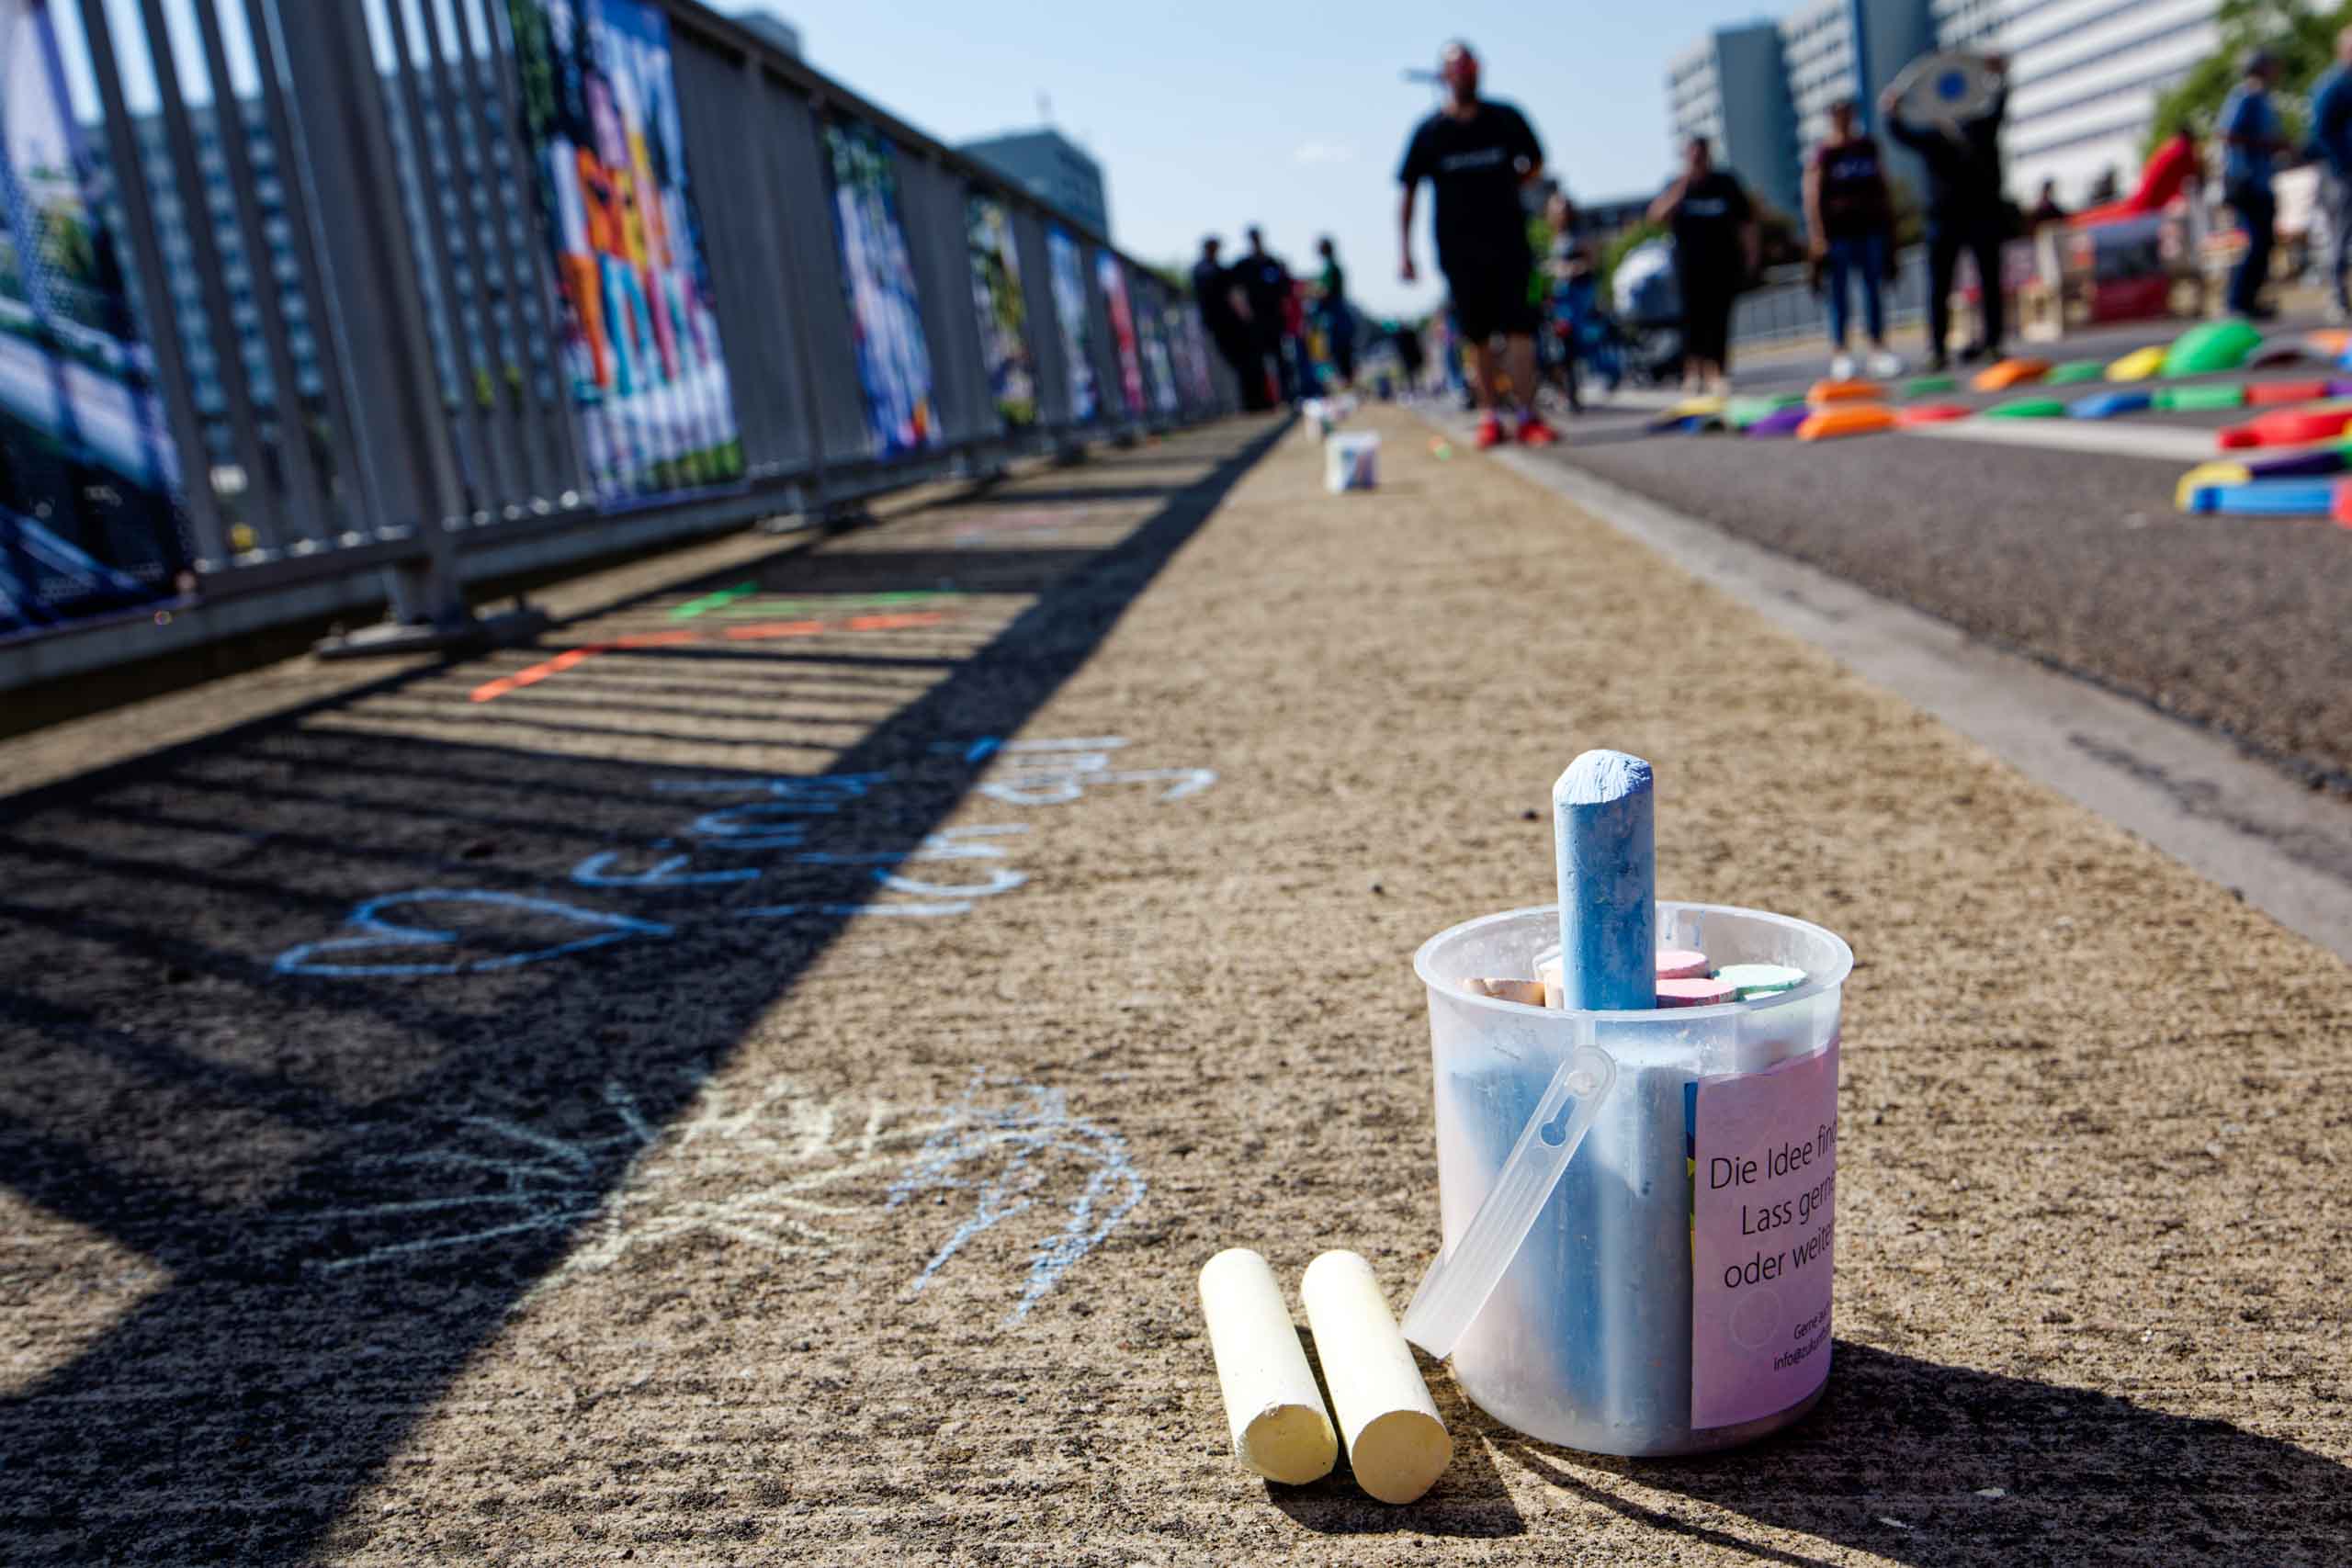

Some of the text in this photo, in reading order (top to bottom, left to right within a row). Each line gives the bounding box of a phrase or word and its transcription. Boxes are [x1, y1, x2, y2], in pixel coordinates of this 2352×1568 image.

[1711, 1156, 1758, 1190] Die
[1767, 1142, 1813, 1180] Idee
[1742, 1201, 1792, 1235] Lass
[1724, 1251, 1786, 1289] oder
